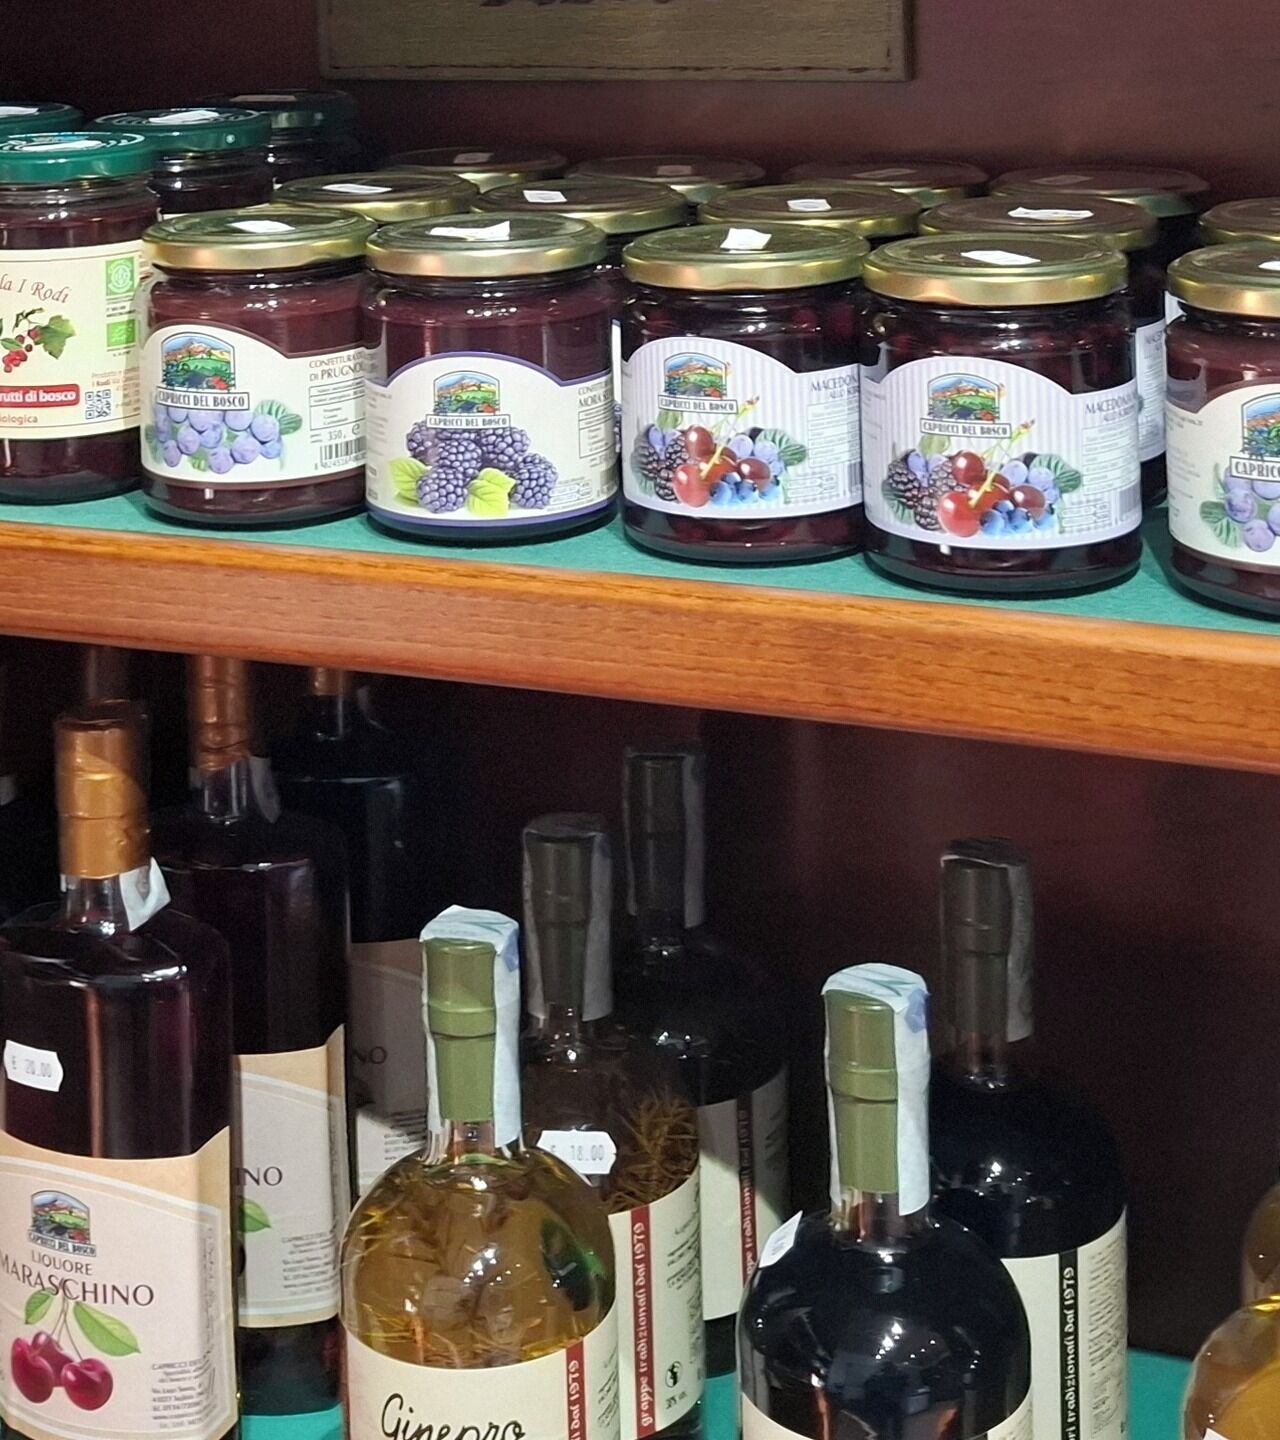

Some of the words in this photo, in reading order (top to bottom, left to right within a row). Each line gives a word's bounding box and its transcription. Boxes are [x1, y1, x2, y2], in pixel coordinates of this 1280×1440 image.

[31, 281, 72, 304] Rodi
[24, 389, 38, 402] di
[39, 389, 77, 402] bosco
[193, 394, 210, 407] DEL
[212, 395, 245, 408] BOSCO
[693, 401, 707, 411] DEL
[709, 401, 735, 412] BOSCO
[465, 417, 480, 427] DEL
[481, 417, 508, 427] BOSCO
[962, 423, 978, 435] DEL
[980, 424, 1008, 436] BOSCO
[569, 1144, 605, 1162] 18.00
[633, 1222, 646, 1259] 1979
[30, 1250, 93, 1276] LIQUORE
[633, 1262, 647, 1286] dal
[1062, 1266, 1075, 1305] 1979
[634, 1287, 649, 1373] tradizionali
[1062, 1307, 1075, 1333] dal
[568, 1360, 580, 1401] 1979
[1062, 1336, 1076, 1423] tradizionali
[639, 1375, 654, 1428] grappe
[569, 1403, 581, 1430] dal
